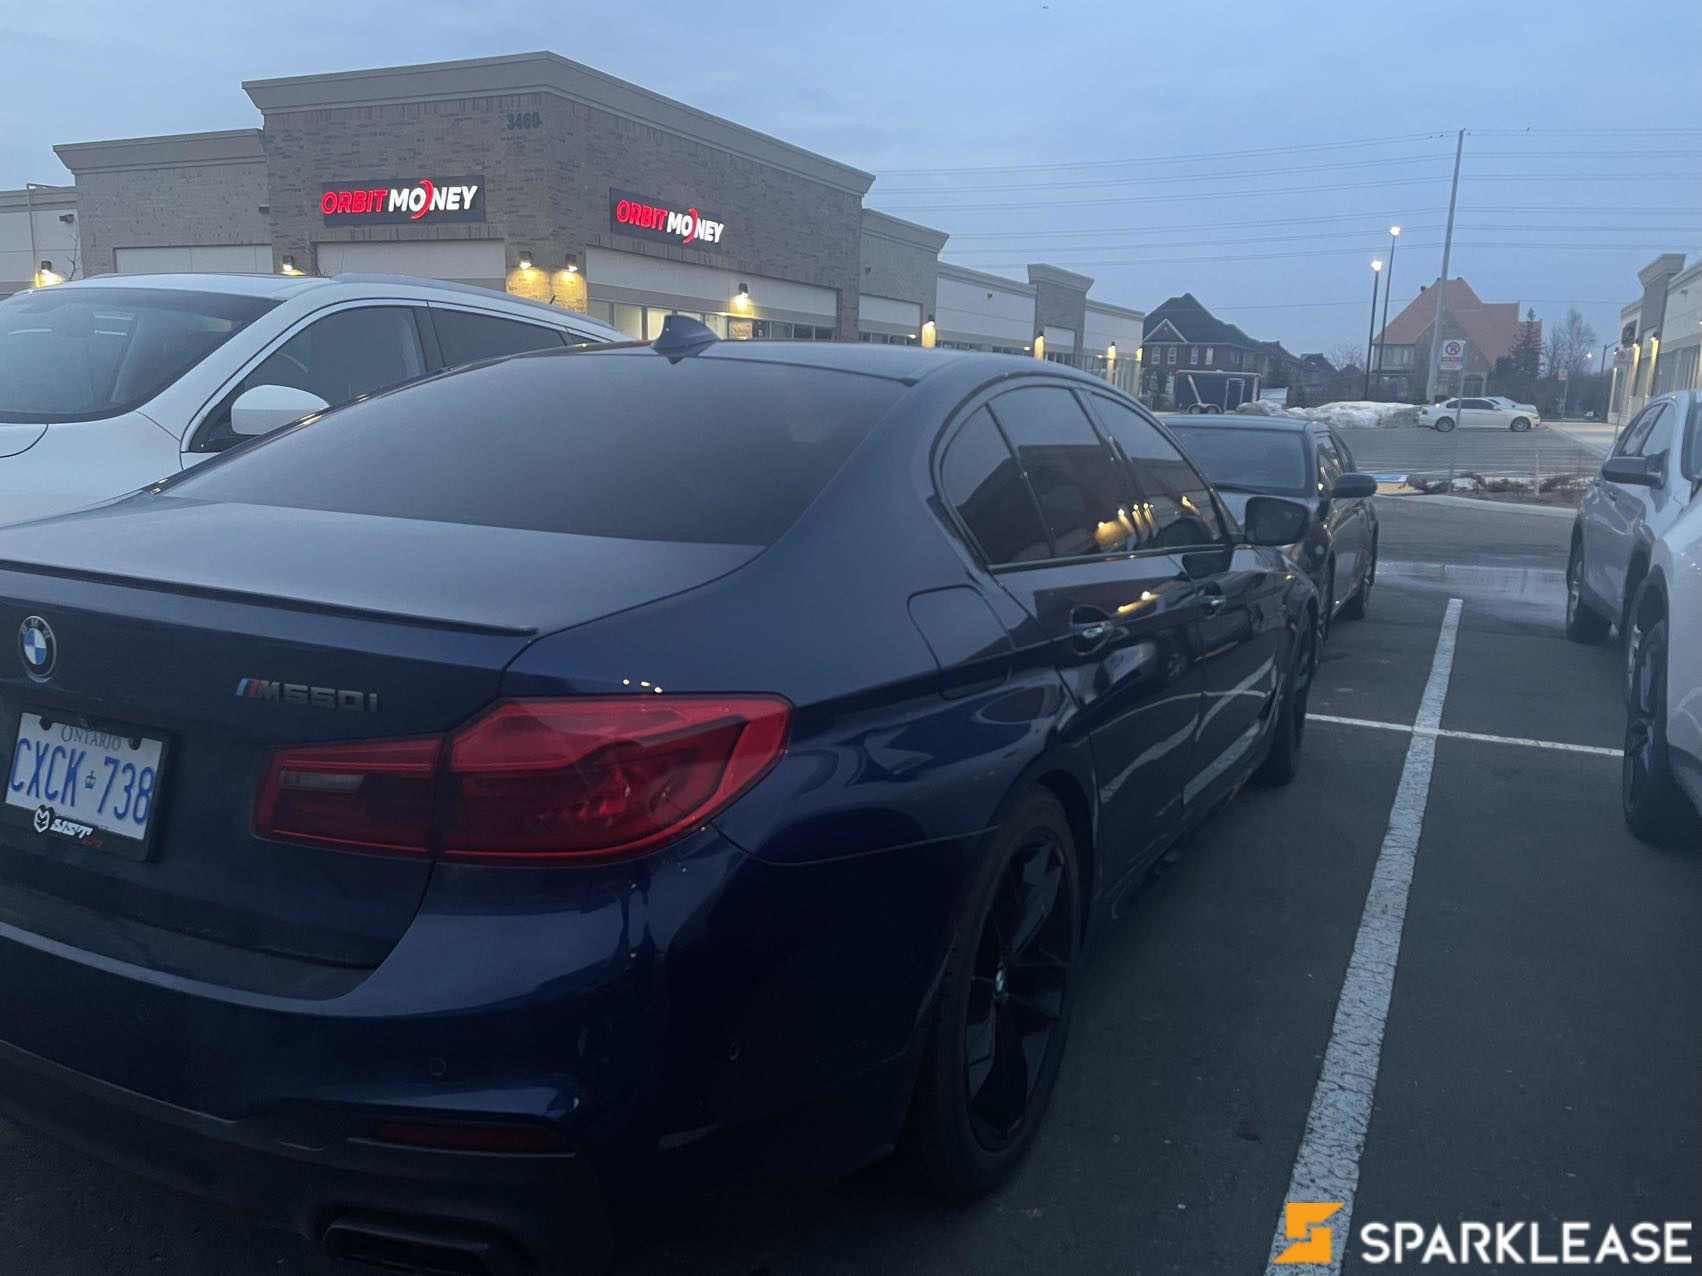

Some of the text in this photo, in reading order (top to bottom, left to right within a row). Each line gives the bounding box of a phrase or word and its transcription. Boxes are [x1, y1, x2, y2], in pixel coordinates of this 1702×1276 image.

[321, 180, 478, 219] ORBIT MONEY
[616, 199, 724, 244] ORBIT MONEY
[61, 724, 121, 751] ONTARIO
[10, 737, 156, 824] CXCK 738
